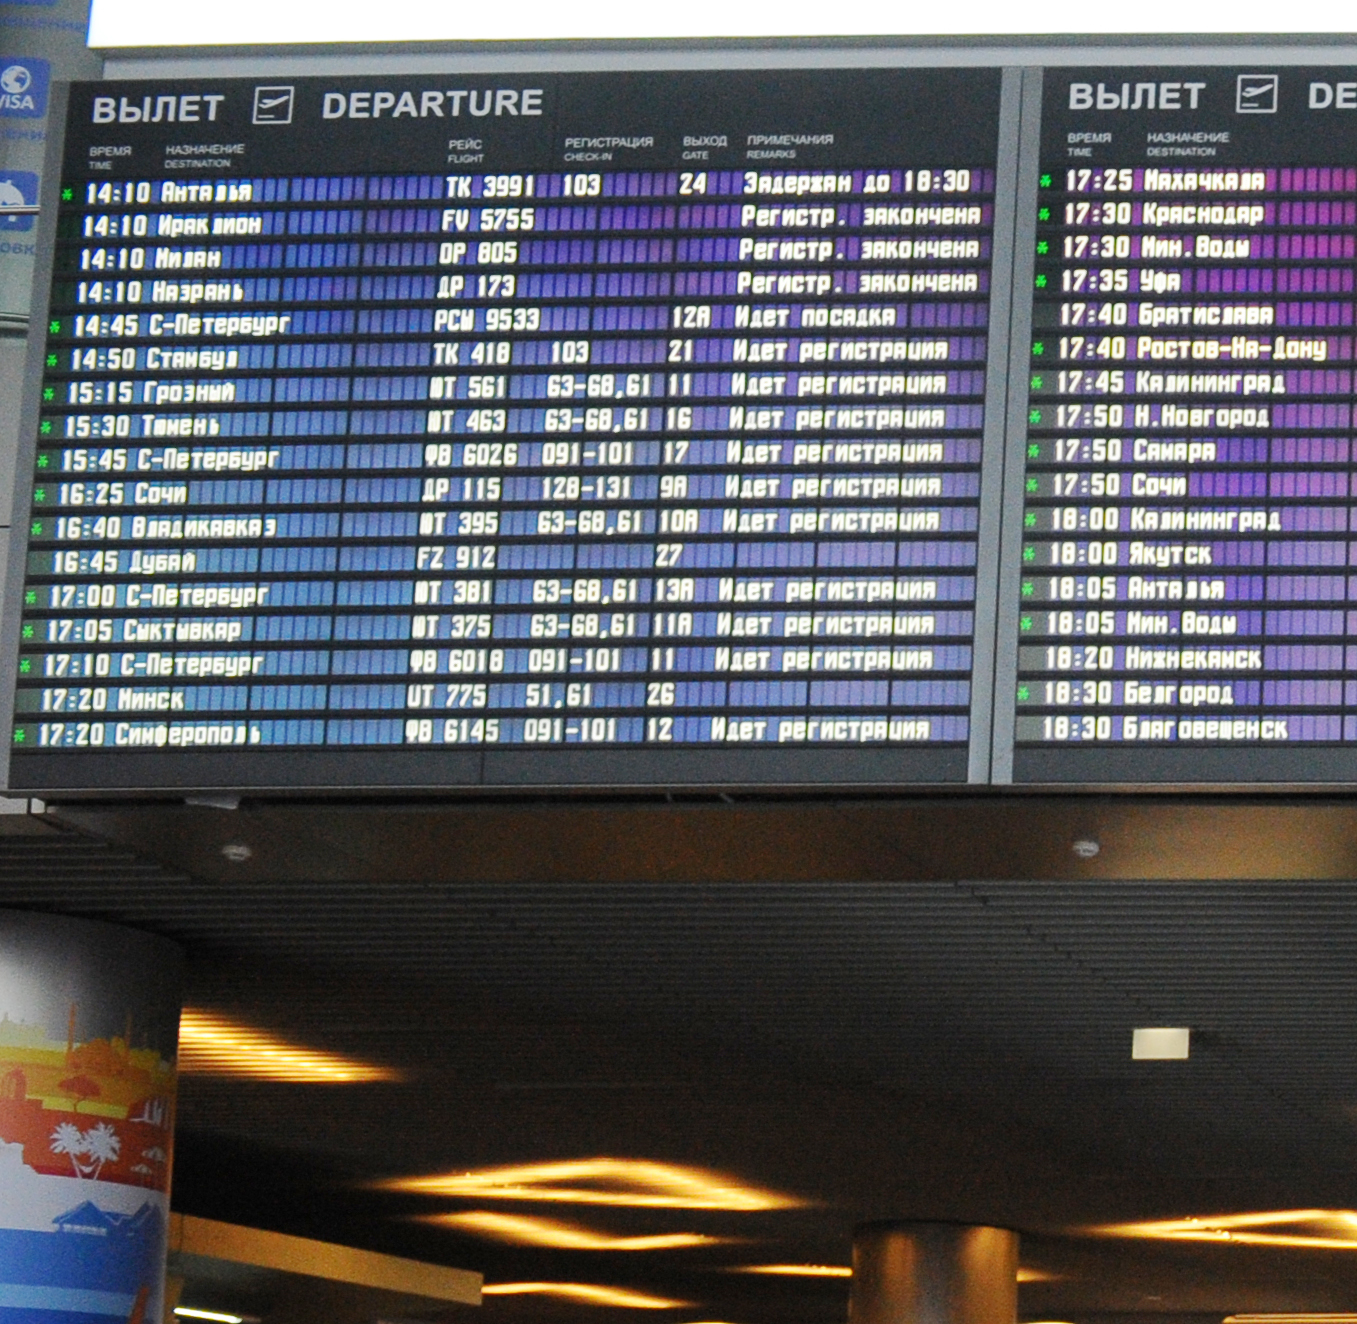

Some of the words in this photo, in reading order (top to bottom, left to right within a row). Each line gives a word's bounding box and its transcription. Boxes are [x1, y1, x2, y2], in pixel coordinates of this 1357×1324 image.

[93, 95, 225, 123] ВЫЛЕТ
[323, 89, 543, 119] DEPARTURE
[1069, 82, 1206, 110] ВЫЛЕТ
[89, 145, 132, 157] ВРЕМЯ
[165, 143, 245, 155] НАЗНАЧЕНИЕ
[448, 137, 483, 151] РЕЙС
[564, 136, 654, 149] РЕГИСТРАЦИЯ
[682, 135, 728, 148] ВЫХОД
[746, 133, 835, 146] ПРИМЕЧАНИЯ
[1067, 132, 1113, 144] ВРЕМЯ
[1146, 131, 1230, 144] НАЗНАЧЕНИЕ
[89, 160, 111, 170] TIME
[164, 158, 231, 169] DESTINATION
[447, 153, 484, 164] FLIGHT
[563, 152, 613, 162] CHECK-IN
[681, 150, 709, 160] GATE
[746, 149, 797, 160] REMARKS
[1067, 147, 1092, 158] TIME
[1146, 146, 1217, 157] DESTINATION
[88, 182, 150, 203] 14:10
[161, 181, 252, 202] Анталья
[483, 175, 533, 197] 3991
[564, 174, 601, 196] 103
[679, 172, 706, 194] 24
[743, 171, 852, 195] Задержан
[863, 174, 890, 193] до
[905, 169, 970, 192] 18:30
[1066, 202, 1131, 225] 17:30
[1143, 202, 1264, 227] Краснодар
[1058, 370, 1124, 393] 17:45
[1136, 370, 1285, 395] Калининград
[67, 415, 130, 437] 15:30
[142, 414, 219, 436] Тюмень
[466, 409, 506, 432] 463
[667, 407, 692, 430] 16
[729, 406, 784, 430] Идет
[796, 409, 945, 431] регистрация
[1051, 541, 1117, 565] 18:00
[1129, 541, 1212, 567] Якутск
[41, 723, 104, 746] 17:20
[115, 722, 260, 747] Симферополь
[444, 719, 499, 743] 6145
[524, 718, 615, 742] 091-101
[648, 717, 673, 741] 12
[711, 717, 767, 741] Идет
[778, 720, 930, 742] регистрация
